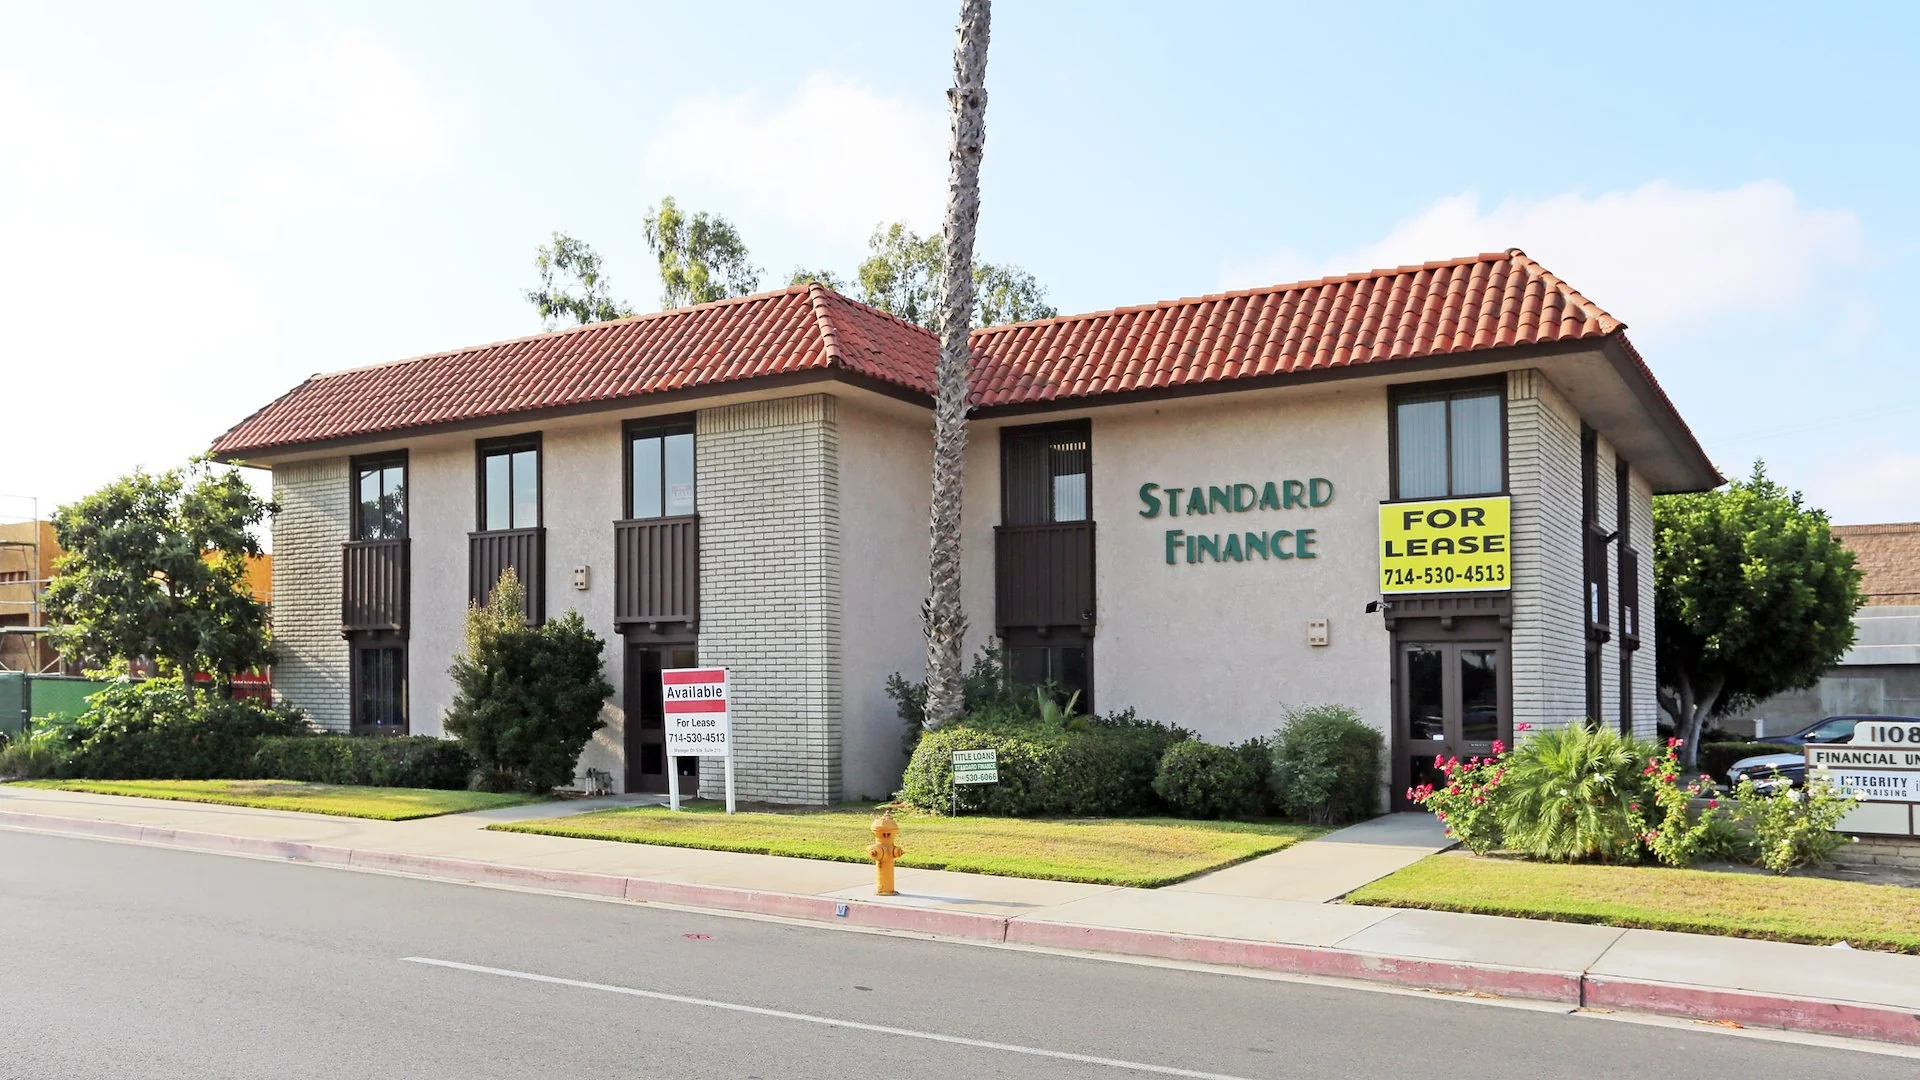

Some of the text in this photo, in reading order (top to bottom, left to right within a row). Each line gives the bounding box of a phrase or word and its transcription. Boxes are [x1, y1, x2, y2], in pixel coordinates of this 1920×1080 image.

[1139, 477, 1334, 518] STANDARD
[1403, 507, 1486, 531] FOR
[1165, 528, 1318, 565] FINANCE
[1385, 534, 1505, 557] LEASE
[1384, 564, 1505, 585] 714-530-4513
[667, 685, 723, 699] Available
[676, 718, 716, 728] For Lease
[669, 732, 726, 743] 714-530-4513
[954, 751, 995, 761] TITLE LOANS
[1816, 752, 1897, 765] FINANCIAL
